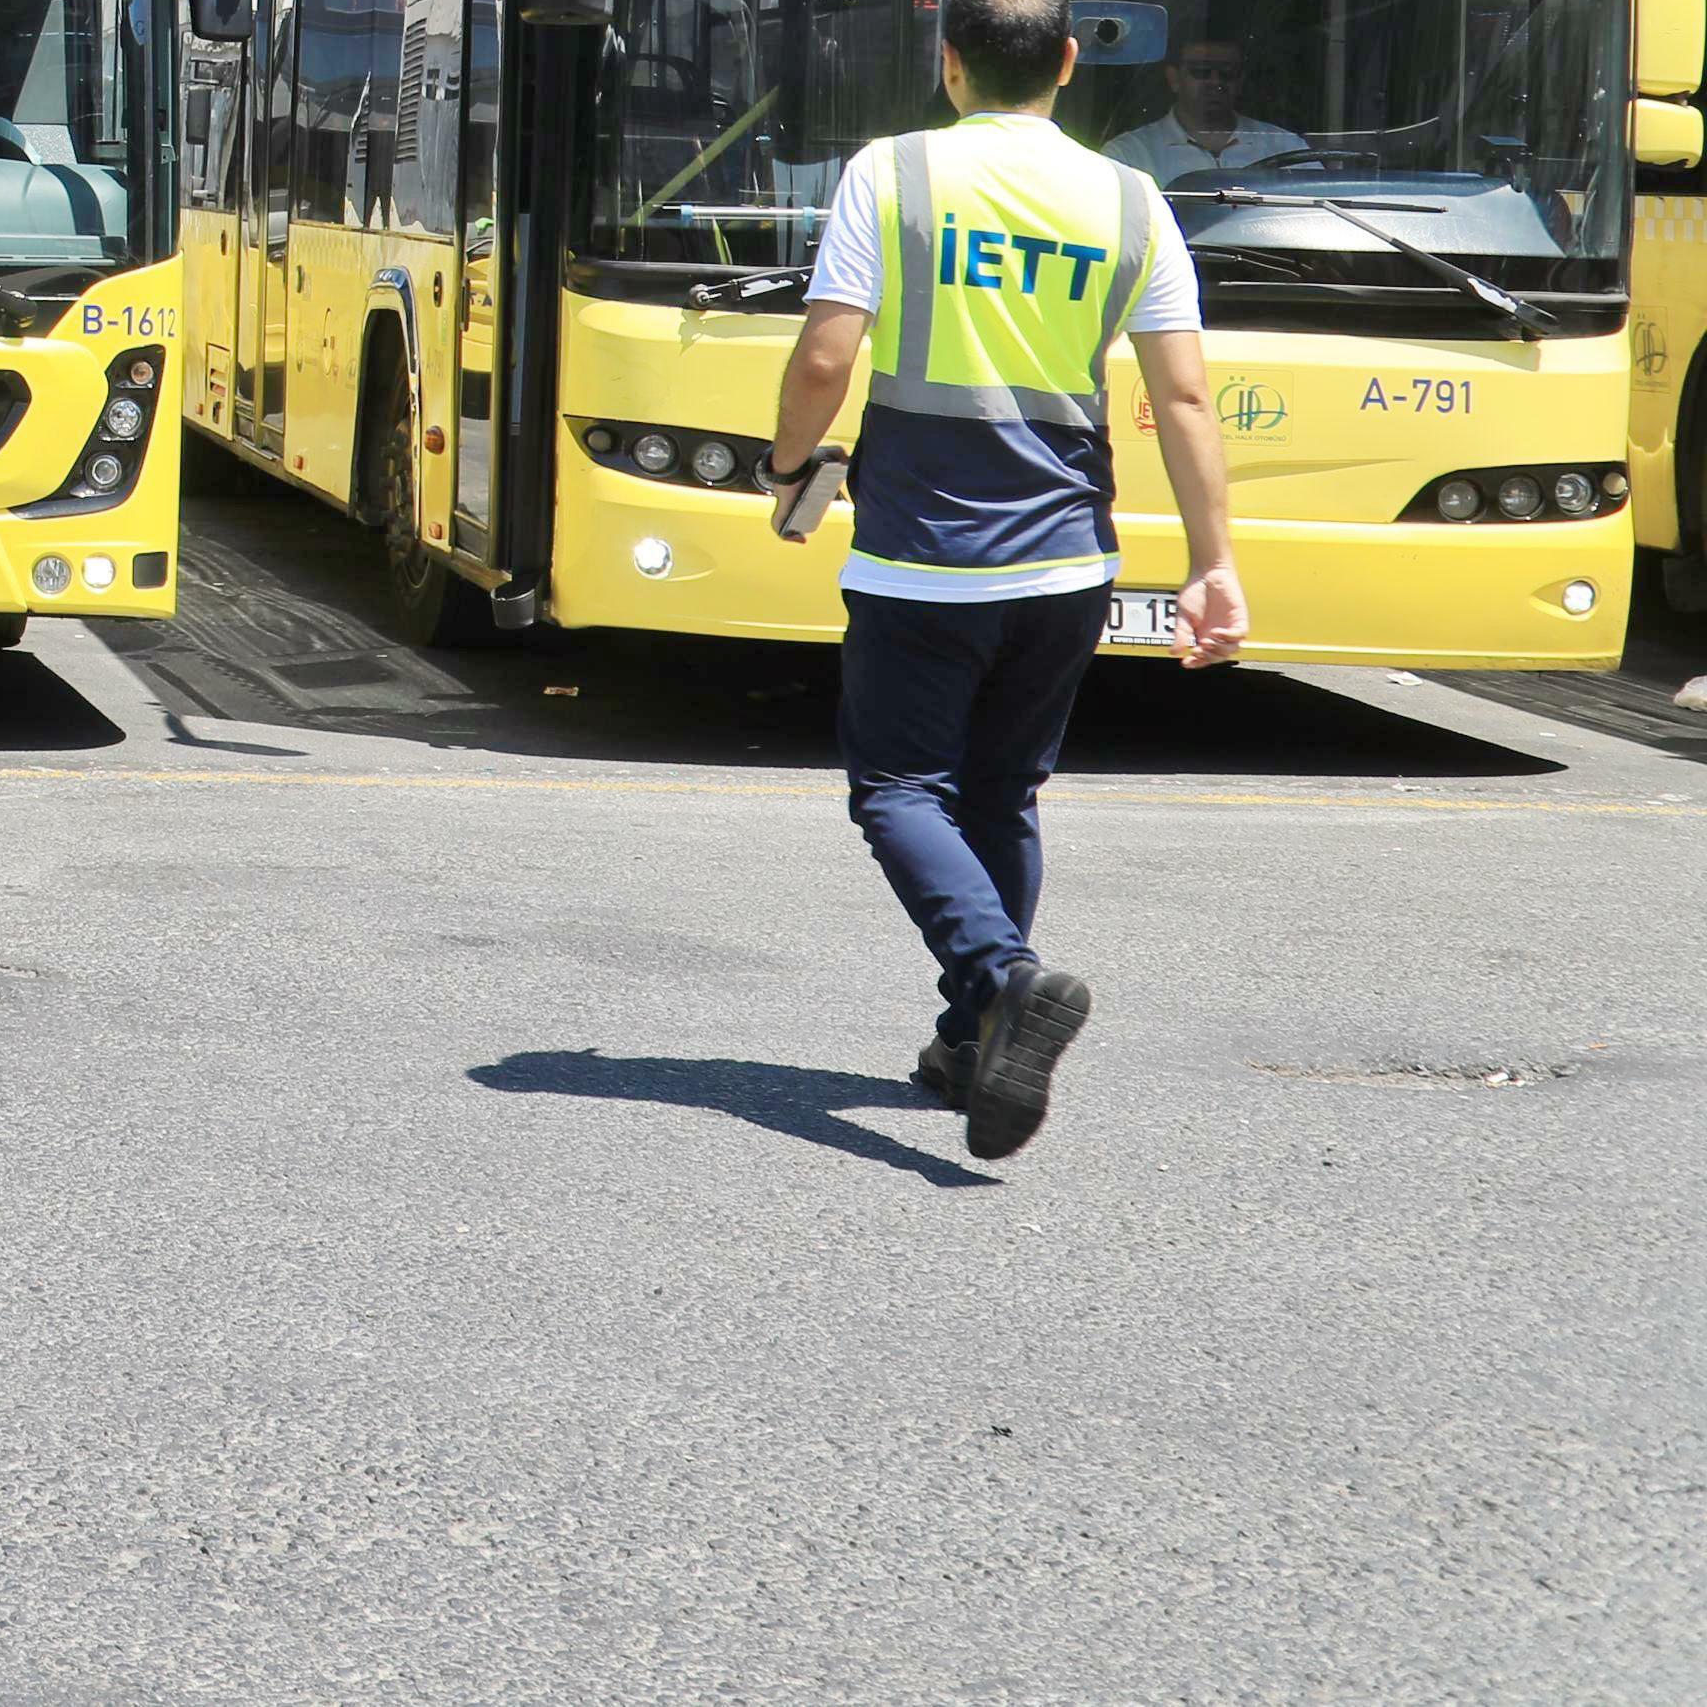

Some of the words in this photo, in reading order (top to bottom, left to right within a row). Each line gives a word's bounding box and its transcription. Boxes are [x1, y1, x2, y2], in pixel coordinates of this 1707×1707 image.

[940, 213, 1106, 301] İETT
[83, 305, 175, 337] B-1612
[1360, 377, 1471, 414] A-791
